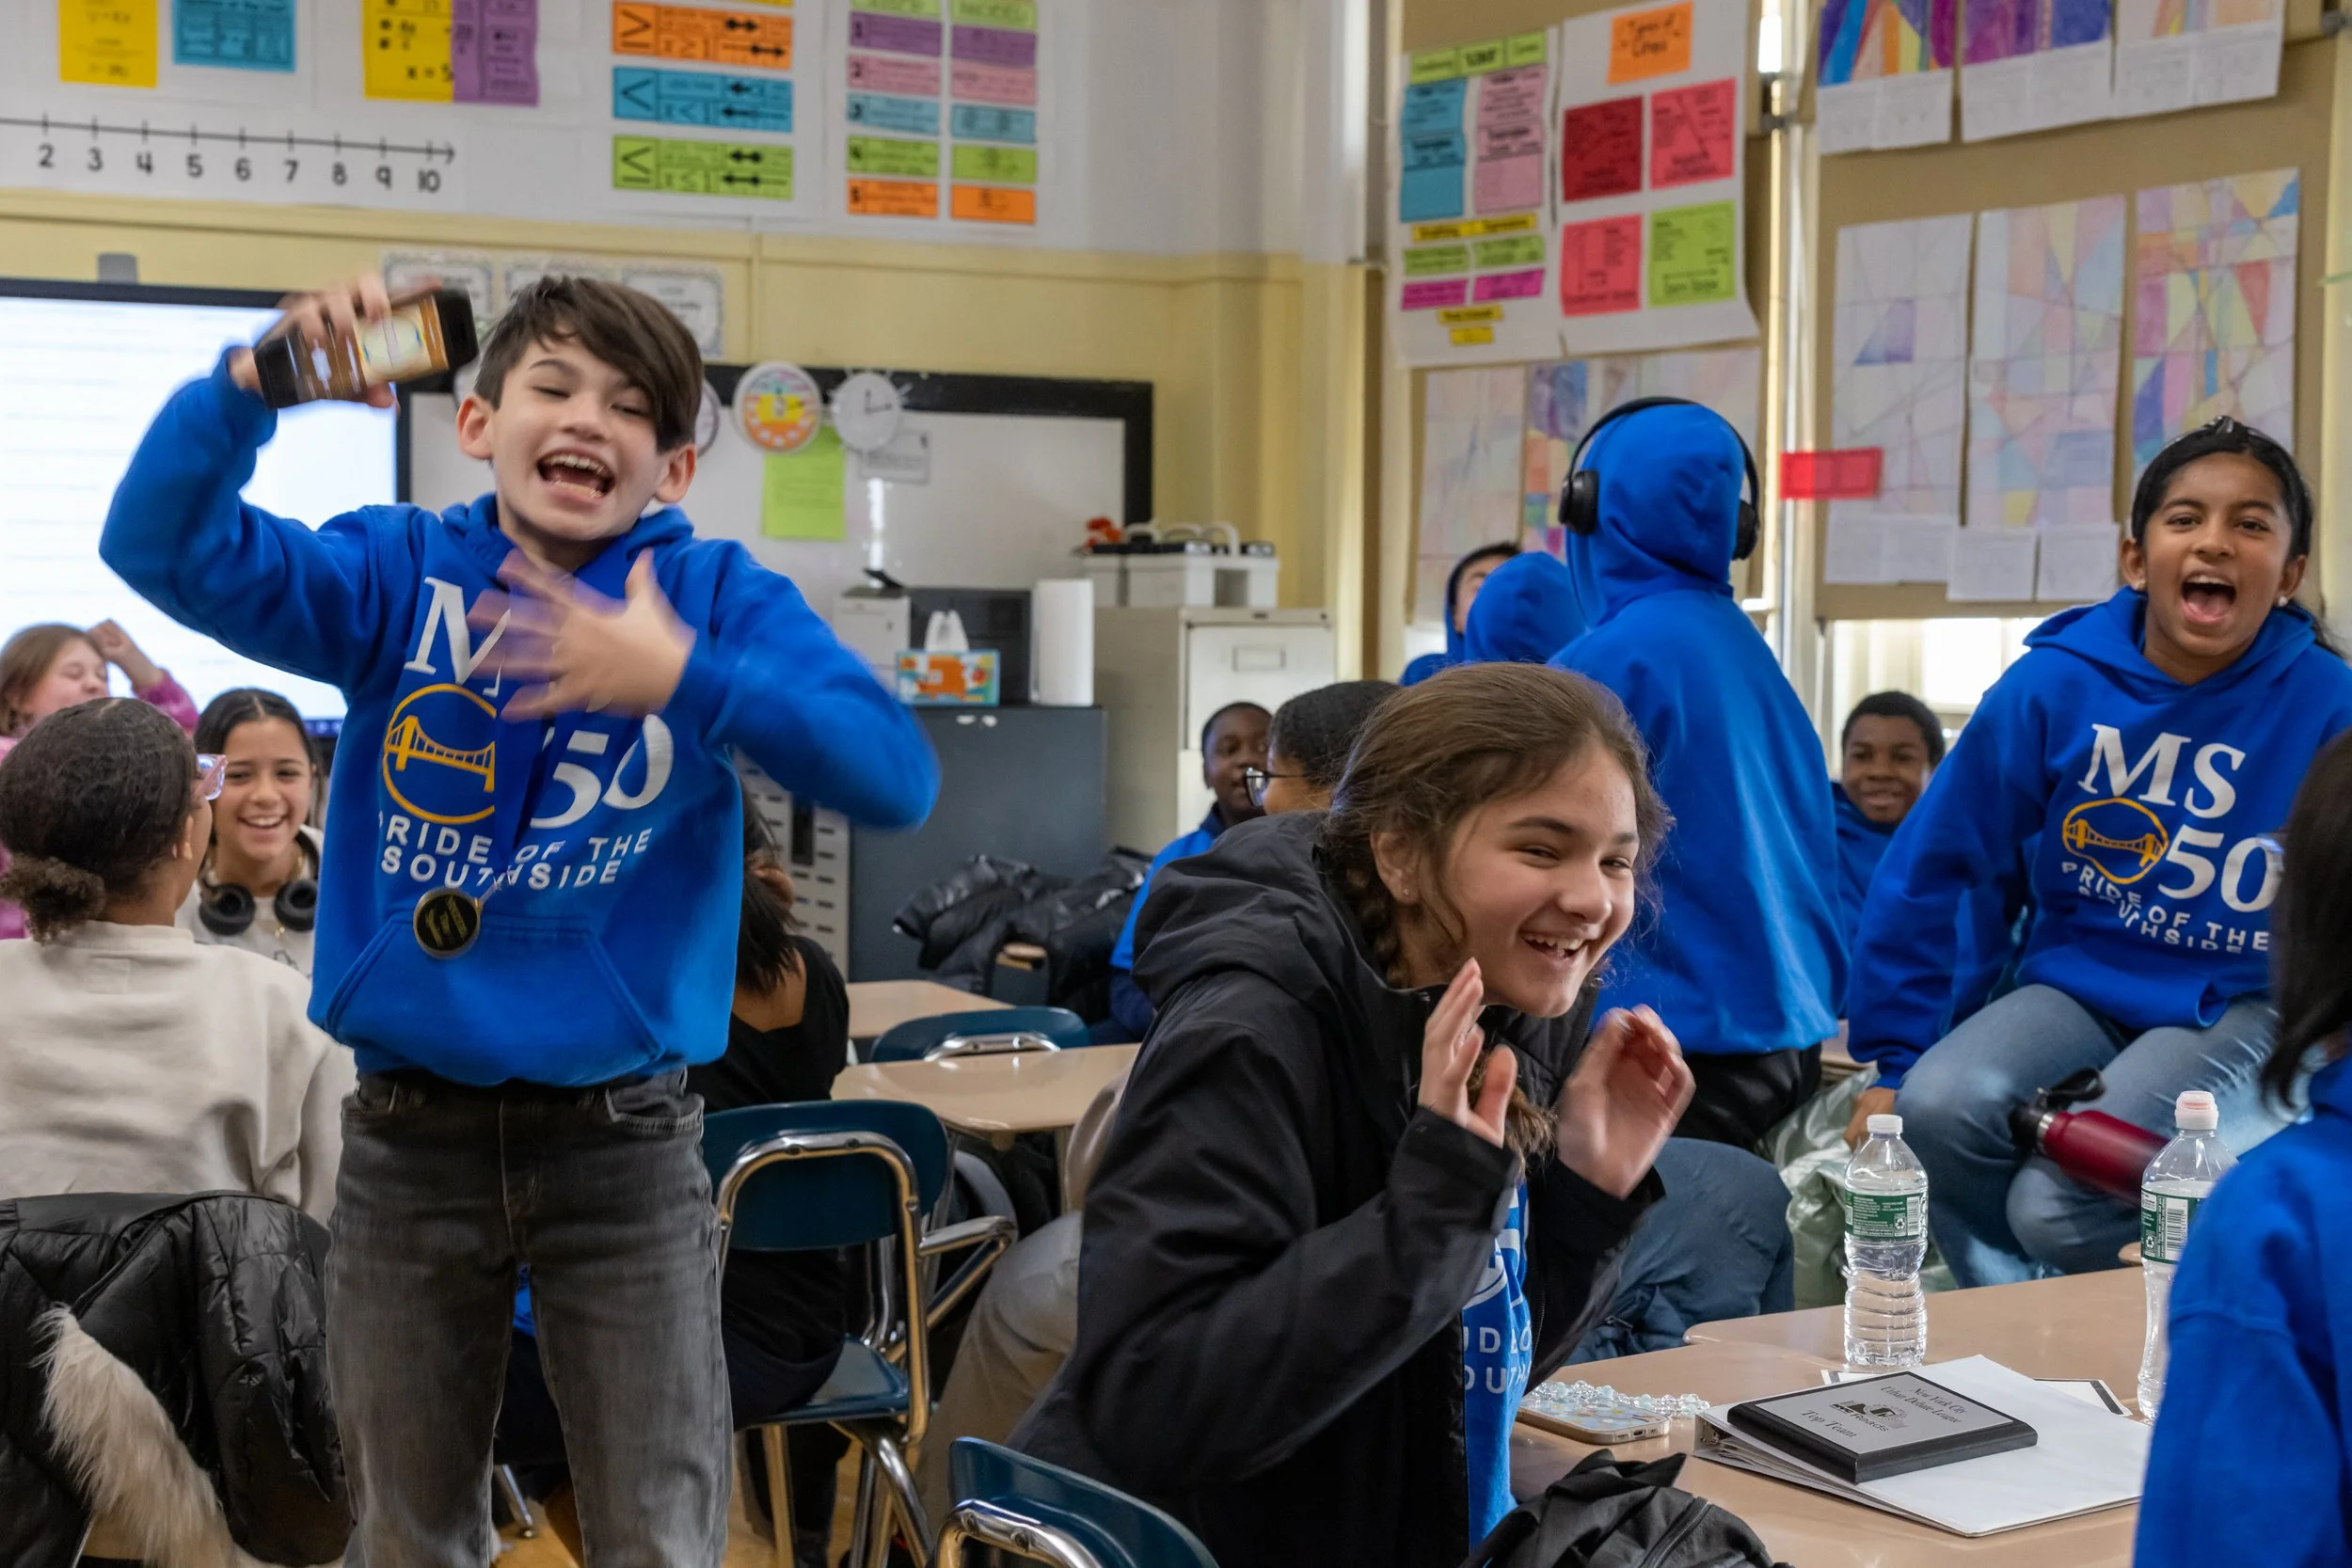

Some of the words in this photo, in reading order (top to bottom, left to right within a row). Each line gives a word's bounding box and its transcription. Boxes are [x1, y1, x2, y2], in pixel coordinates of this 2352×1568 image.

[39, 142, 55, 168] 2
[87, 147, 103, 172] 3
[135, 150, 153, 175] 4
[186, 153, 204, 179] 5
[235, 157, 252, 182] 6
[283, 159, 299, 182] 7
[331, 162, 347, 186] 8
[376, 166, 392, 190] 9
[418, 169, 441, 193] 10
[531, 713, 675, 829] 50
[2077, 722, 2247, 818] MS
[378, 811, 493, 865] RIDE
[589, 828, 653, 863] THE
[2157, 824, 2284, 912] 50
[2148, 905, 2191, 927] OF
[2206, 922, 2269, 951] THE
[1881, 1386, 1907, 1400] Urban
[1904, 1397, 1934, 1411] Debate
[1931, 1409, 1962, 1423] League
[1914, 1387, 1931, 1398] New
[1929, 1396, 1953, 1407] York
[1802, 1410, 1825, 1423] Top
[1825, 1420, 1857, 1437] Team
